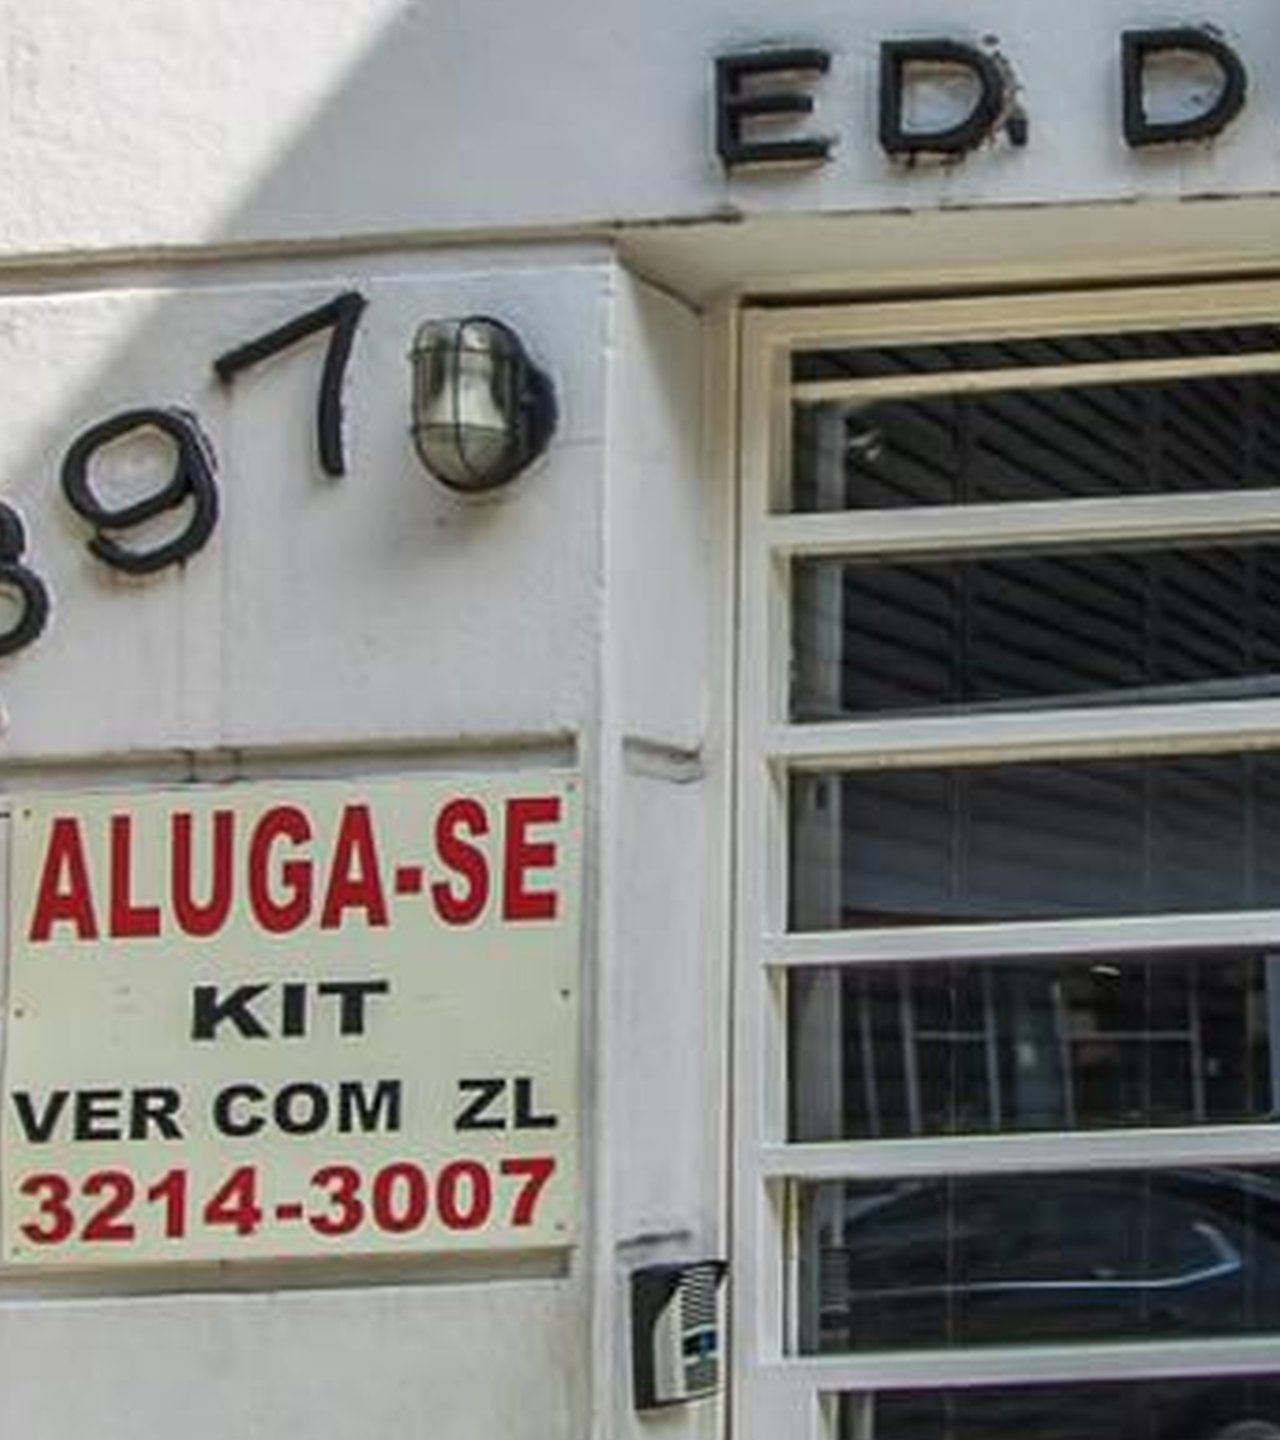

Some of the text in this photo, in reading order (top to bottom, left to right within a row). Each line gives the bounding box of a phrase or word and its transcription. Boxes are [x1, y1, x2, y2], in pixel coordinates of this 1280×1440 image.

[29, 795, 561, 942] ALUGA-SE
[191, 980, 390, 1041] KIT
[12, 1077, 559, 1143] VER COM ZL
[19, 1157, 557, 1244] 3214-3007
